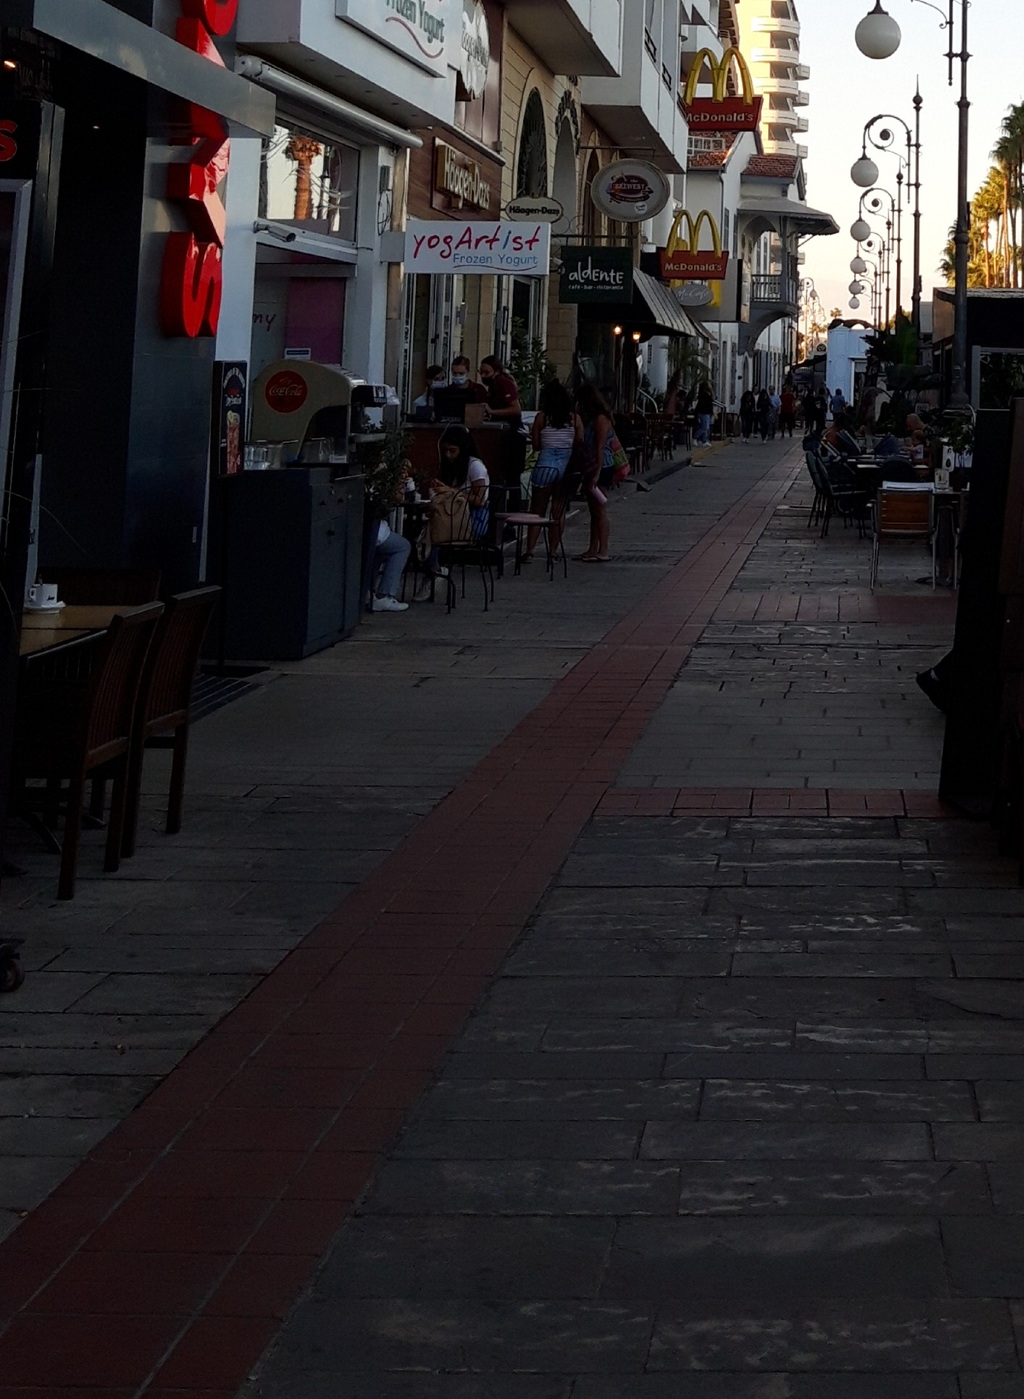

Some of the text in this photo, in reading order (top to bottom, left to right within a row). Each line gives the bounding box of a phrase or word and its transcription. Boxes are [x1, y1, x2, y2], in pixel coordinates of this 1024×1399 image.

[686, 112, 754, 122] McDonald's
[509, 206, 560, 216] Häagen-Dazs
[413, 225, 541, 259] yogArtist
[453, 253, 538, 267] Frozen Yogurt
[664, 262, 723, 272] McDonald's
[268, 384, 304, 397] Coca-Cola
